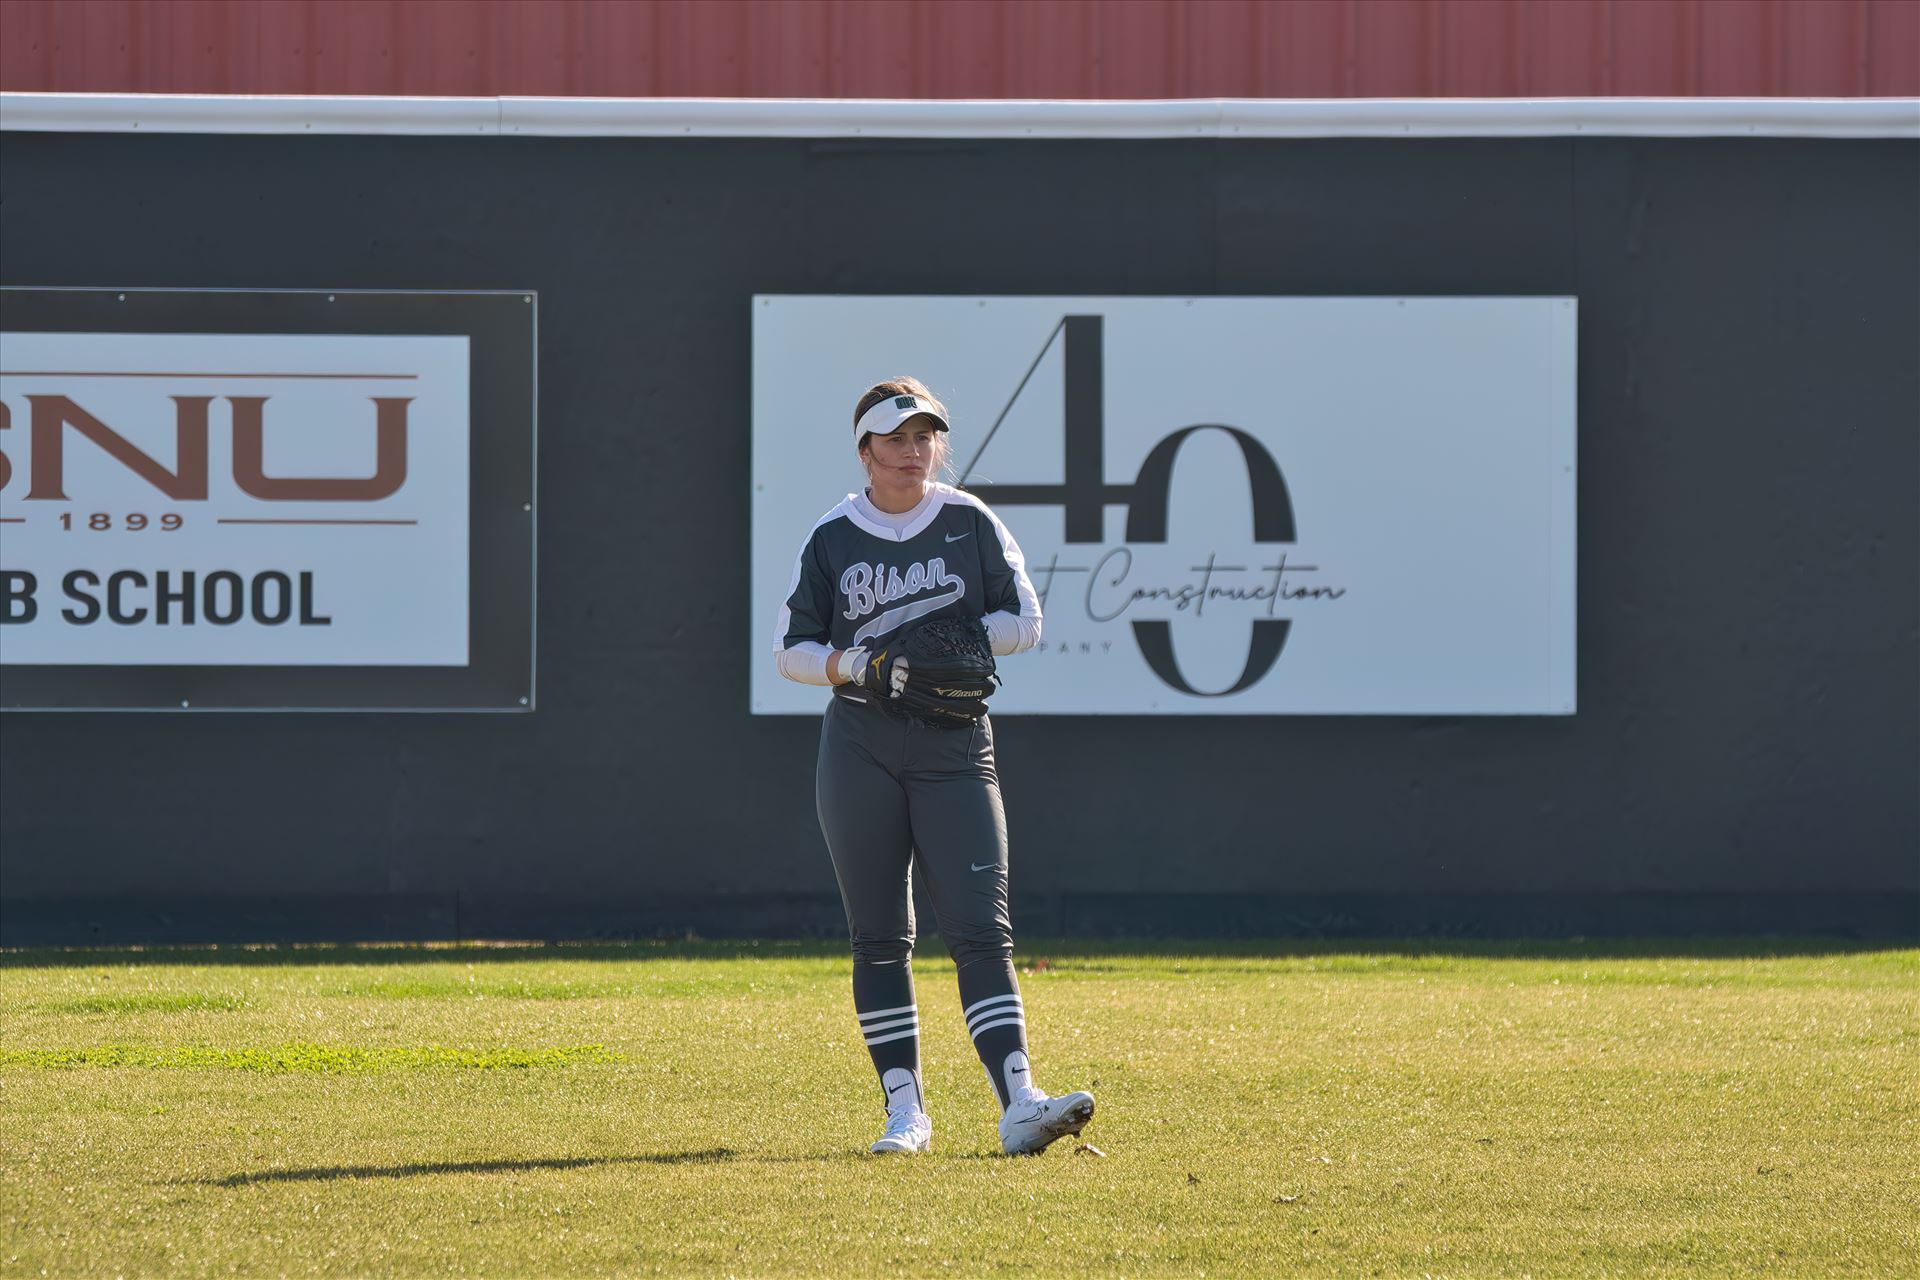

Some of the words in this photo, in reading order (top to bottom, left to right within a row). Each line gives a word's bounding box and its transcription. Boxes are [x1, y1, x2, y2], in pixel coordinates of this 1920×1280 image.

[0, 394, 417, 502] NU
[59, 512, 183, 532] 1899
[61, 569, 332, 626] SCHOOL
[840, 557, 965, 620] Bison
[1085, 546, 1345, 623] Construction
[1040, 641, 1112, 653] PANY
